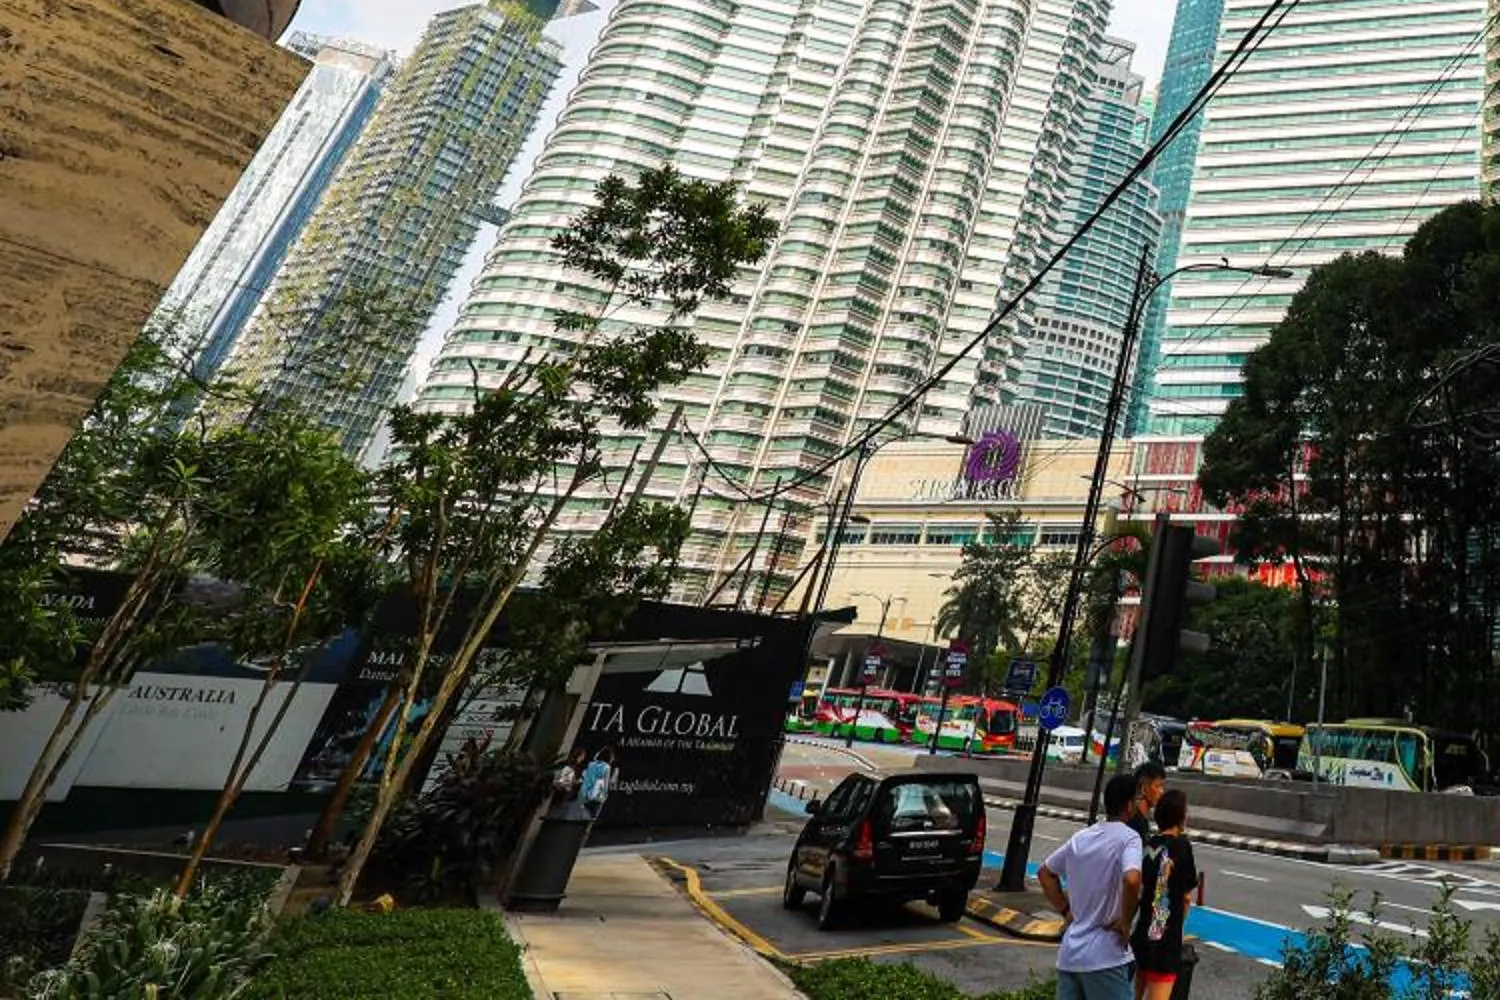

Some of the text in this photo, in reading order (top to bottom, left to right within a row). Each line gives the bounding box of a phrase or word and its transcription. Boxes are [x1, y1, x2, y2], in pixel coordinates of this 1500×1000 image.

[128, 684, 236, 705] AUSTRALIA
[589, 702, 740, 738] TA GLOBAL
